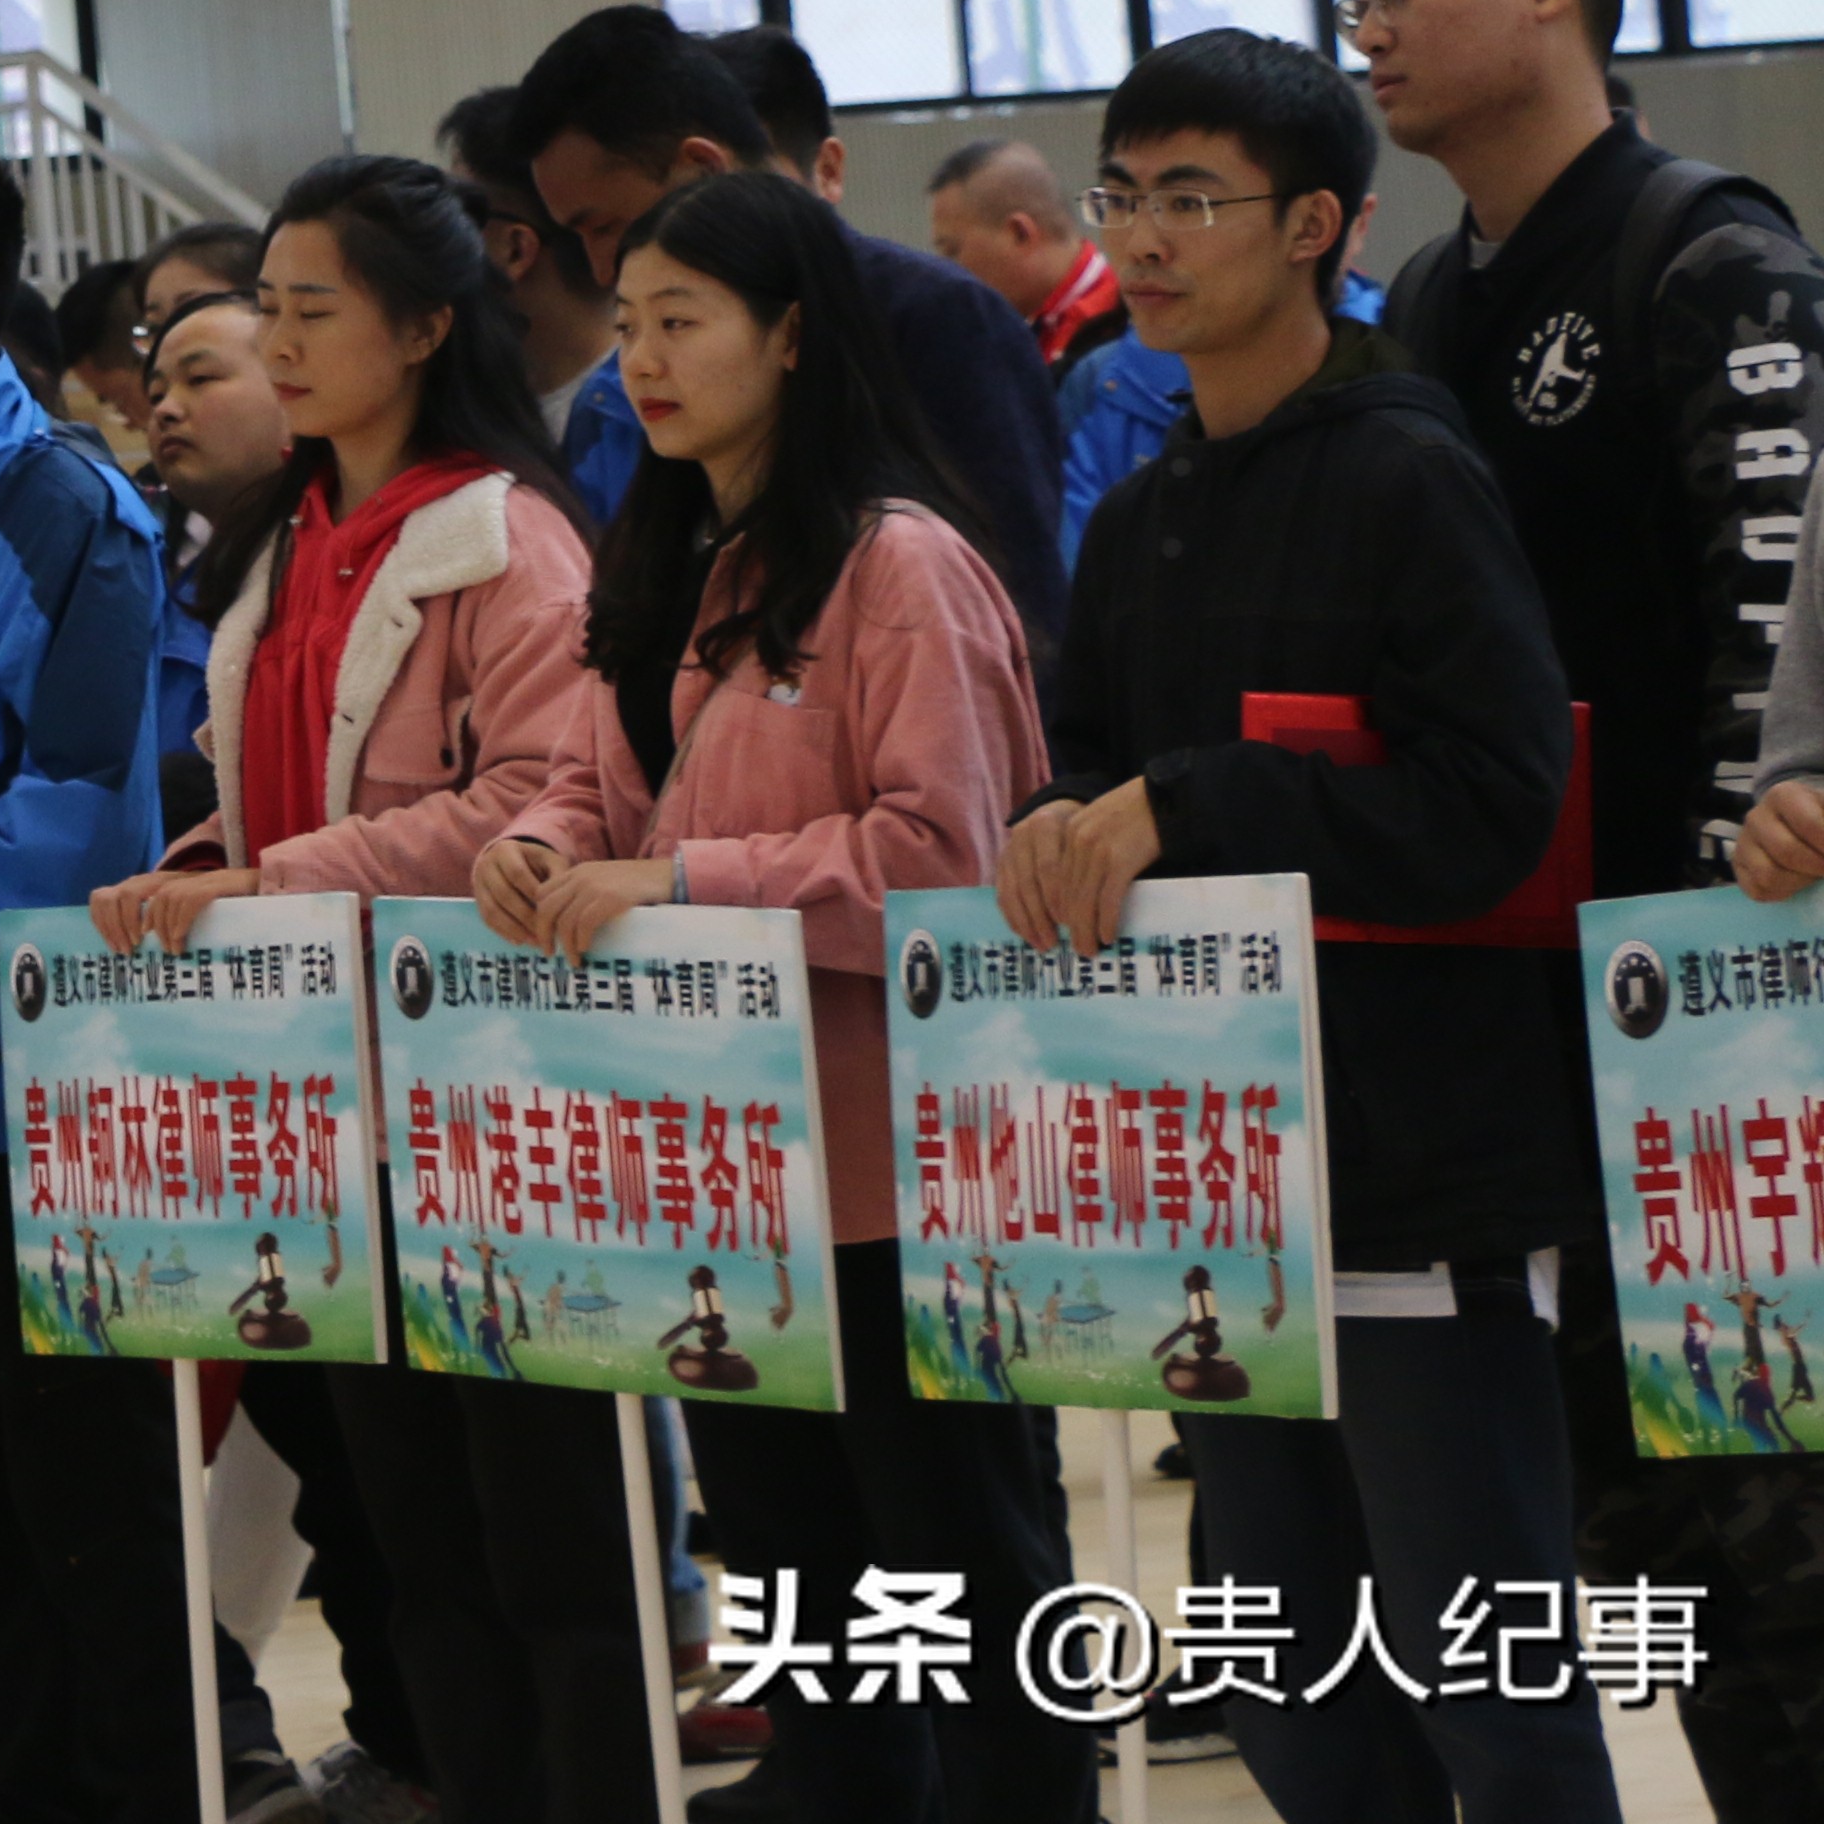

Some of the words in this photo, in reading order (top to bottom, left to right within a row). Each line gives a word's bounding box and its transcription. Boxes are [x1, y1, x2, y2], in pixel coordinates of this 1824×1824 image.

[407, 1077, 790, 1254] 贵州港丰律师事务所
[912, 1078, 1285, 1251] 贵州他山律师事务所
